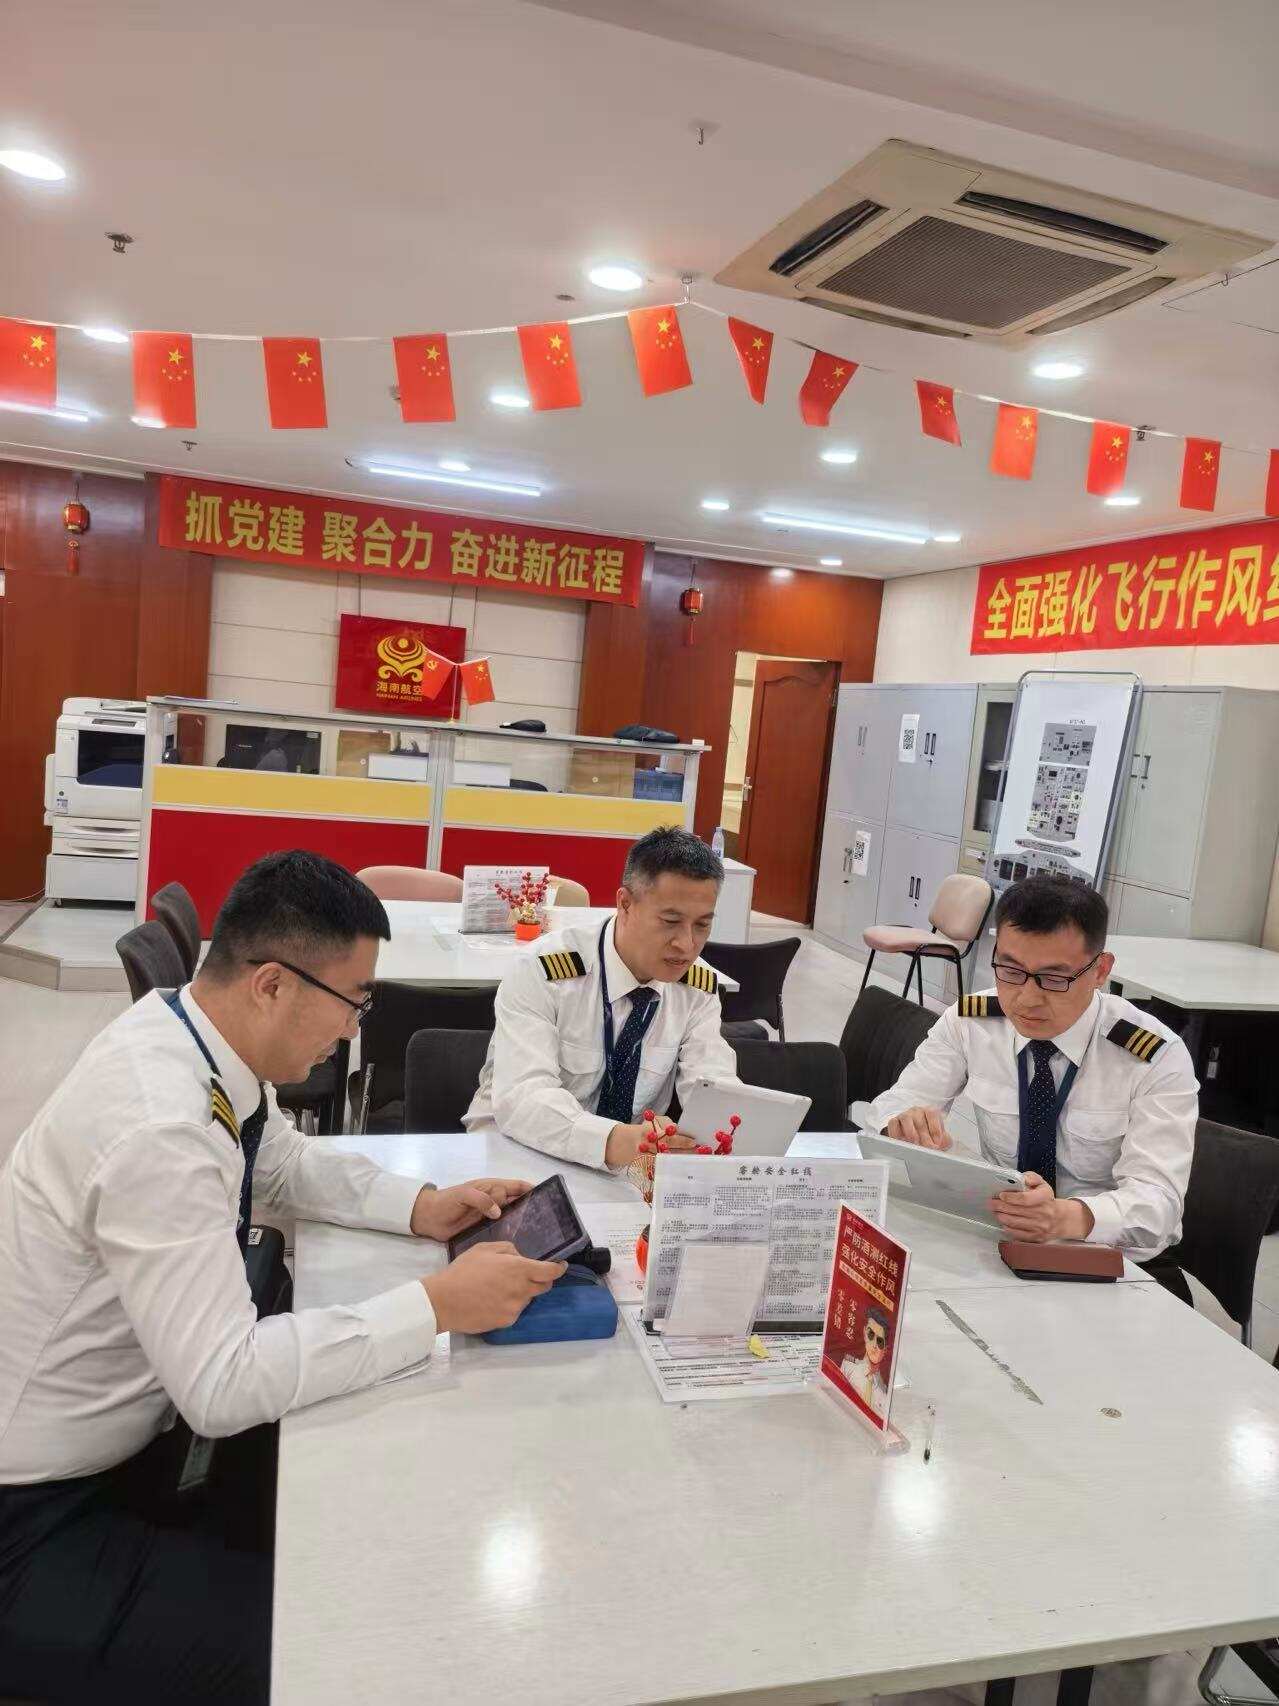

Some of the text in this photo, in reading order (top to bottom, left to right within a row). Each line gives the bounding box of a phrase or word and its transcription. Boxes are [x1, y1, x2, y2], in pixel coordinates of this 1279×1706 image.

[185, 491, 625, 595] 抓党建 聚合力 奋进新征程
